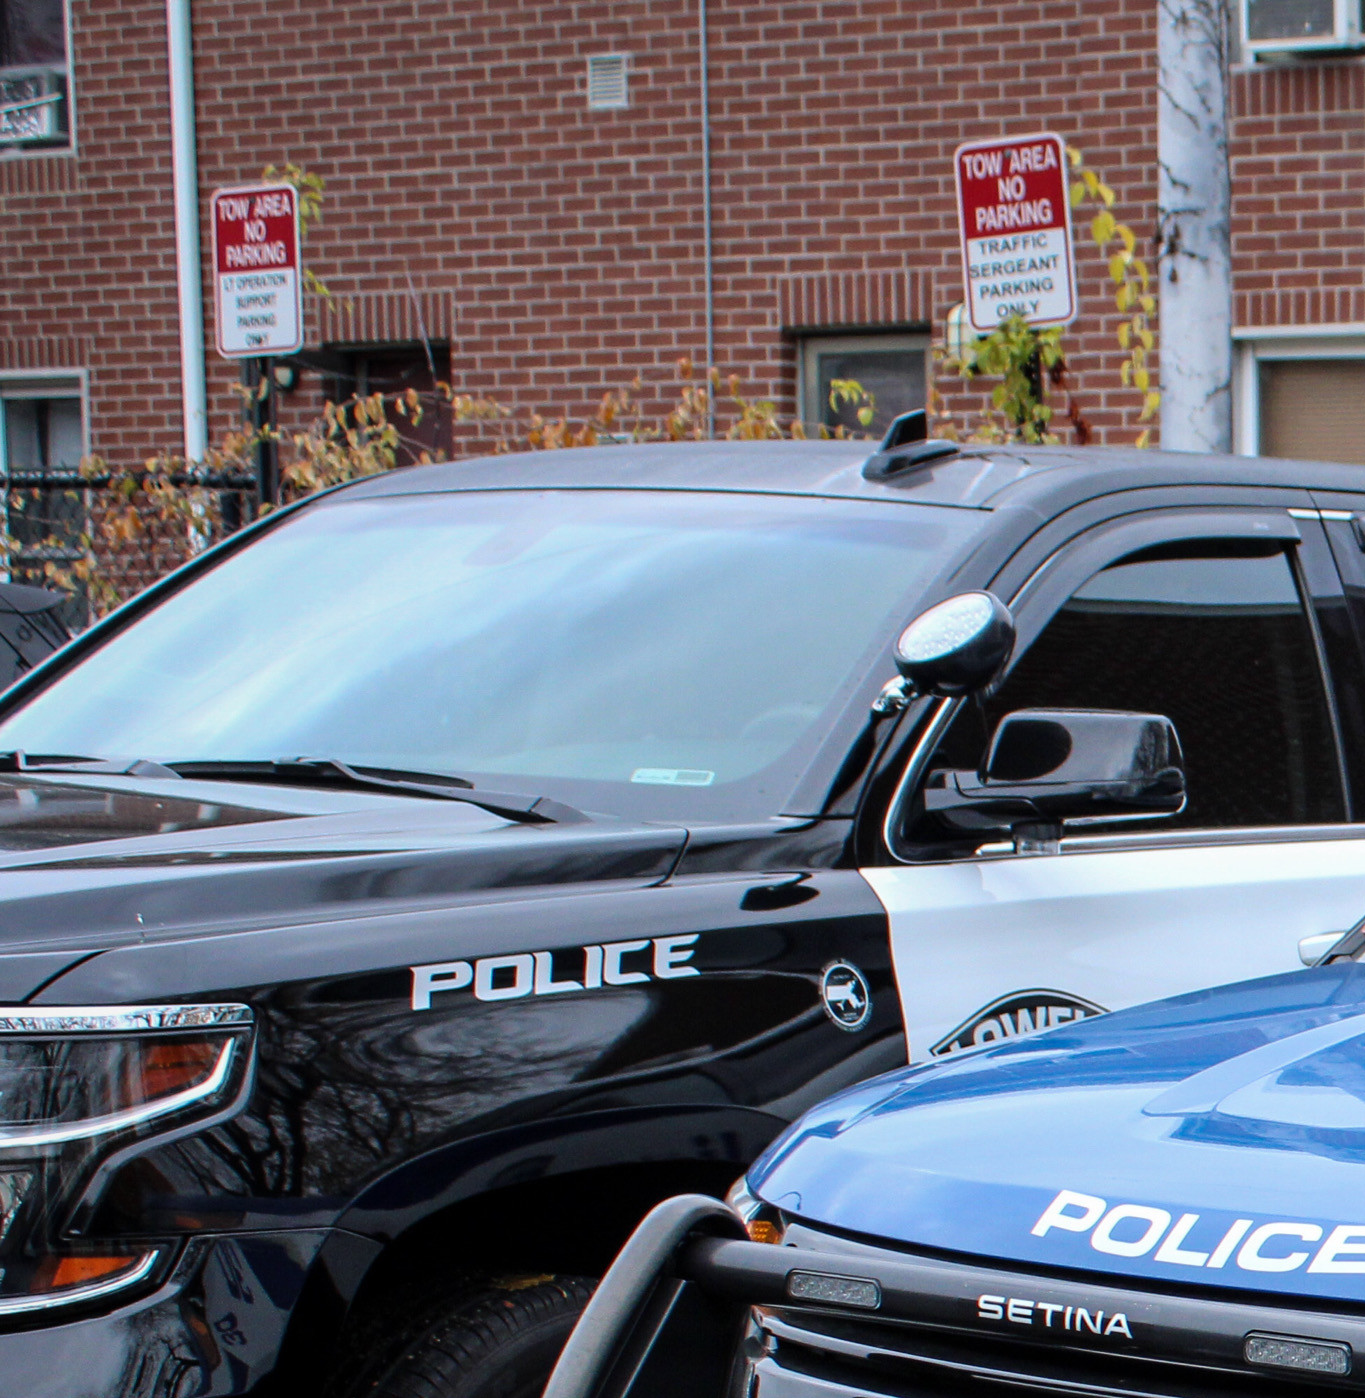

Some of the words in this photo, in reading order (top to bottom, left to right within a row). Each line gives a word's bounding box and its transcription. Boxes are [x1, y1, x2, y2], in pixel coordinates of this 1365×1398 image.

[962, 150, 1004, 180] TOW
[1008, 144, 1058, 174] AREA
[998, 174, 1026, 202] NO
[217, 198, 249, 221] TOW
[254, 193, 292, 218] AREA
[975, 198, 1054, 232] PARKING
[244, 219, 267, 242] NO
[978, 232, 1048, 254] TRAFFIC
[225, 240, 287, 268] PARKING
[969, 254, 1059, 279] SERGEANT
[980, 277, 1054, 299] PARKING
[996, 300, 1040, 317] ONLY
[409, 934, 700, 1011] POLICE
[977, 1294, 1133, 1339] SETINA
